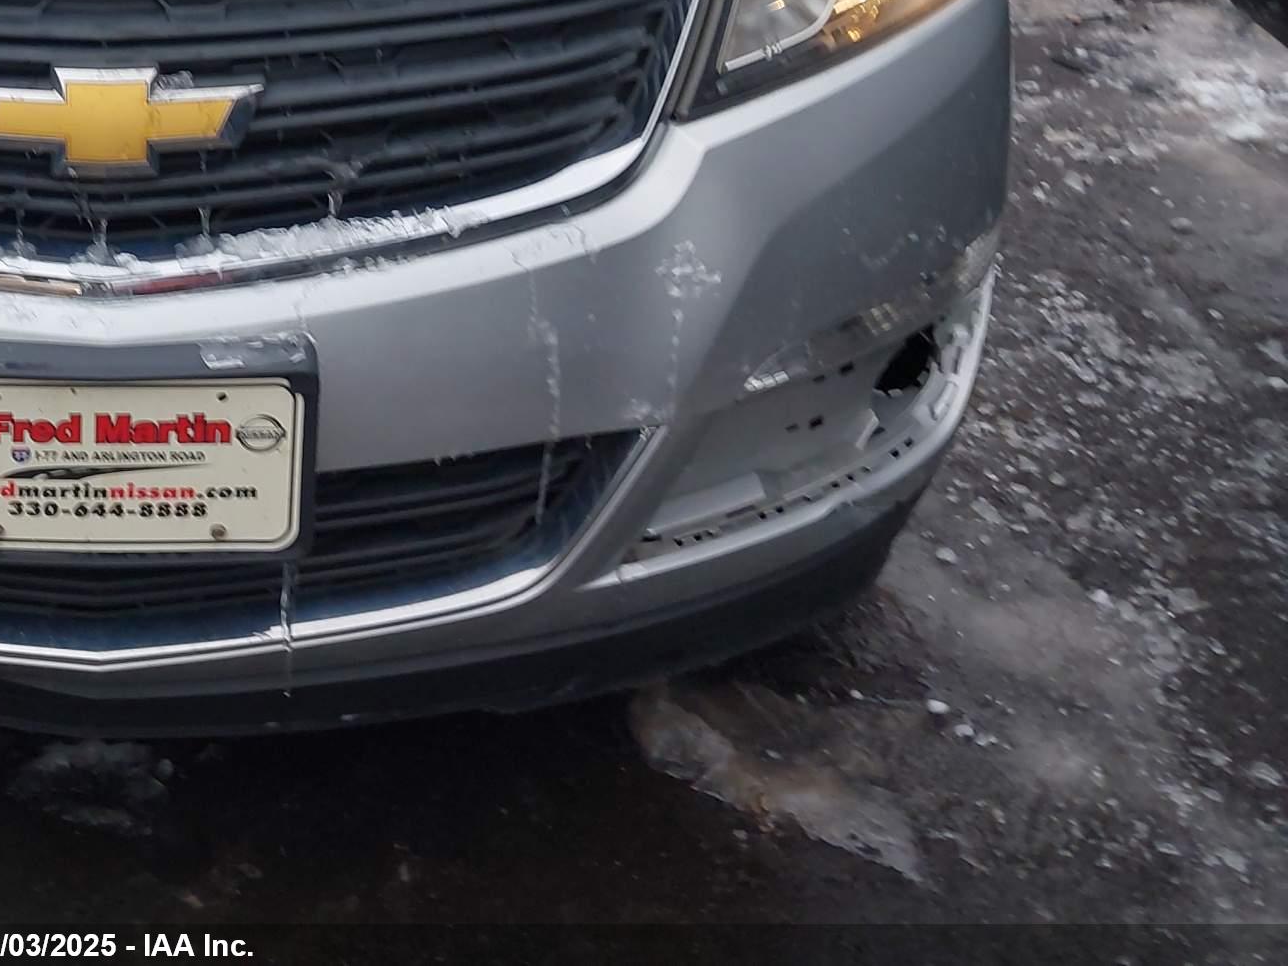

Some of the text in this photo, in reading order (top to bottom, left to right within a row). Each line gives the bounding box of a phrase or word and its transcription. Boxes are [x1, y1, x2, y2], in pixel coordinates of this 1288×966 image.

[95, 412, 233, 446] Martin
[61, 450, 89, 462] AND
[91, 450, 167, 463] ARLINGTON
[169, 450, 207, 463] ROAD
[8, 500, 208, 518] 330-644-8888
